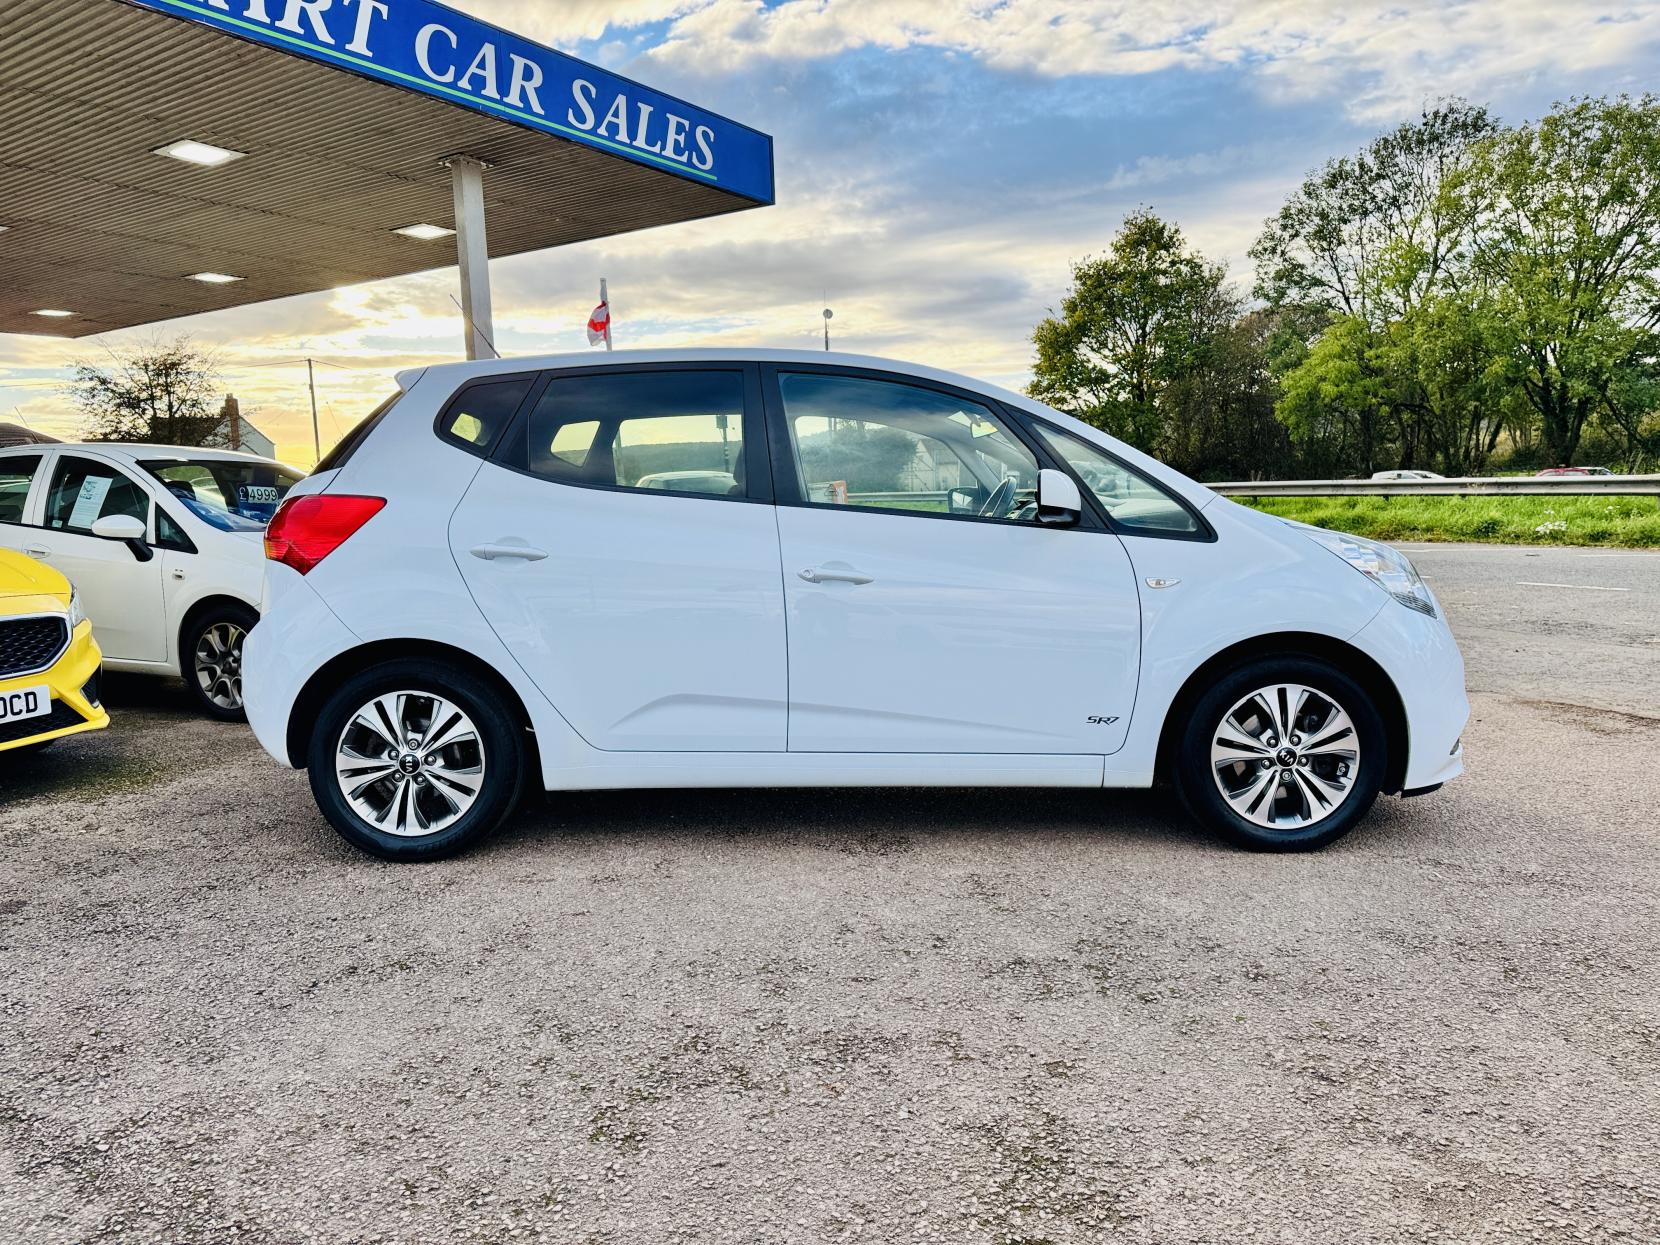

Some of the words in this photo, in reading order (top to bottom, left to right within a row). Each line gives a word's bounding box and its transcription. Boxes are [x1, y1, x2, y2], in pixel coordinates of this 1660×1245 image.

[415, 24, 545, 115] CAR
[567, 79, 716, 171] SALES
[239, 486, 278, 502] £4999
[1086, 715, 1120, 725] SR7
